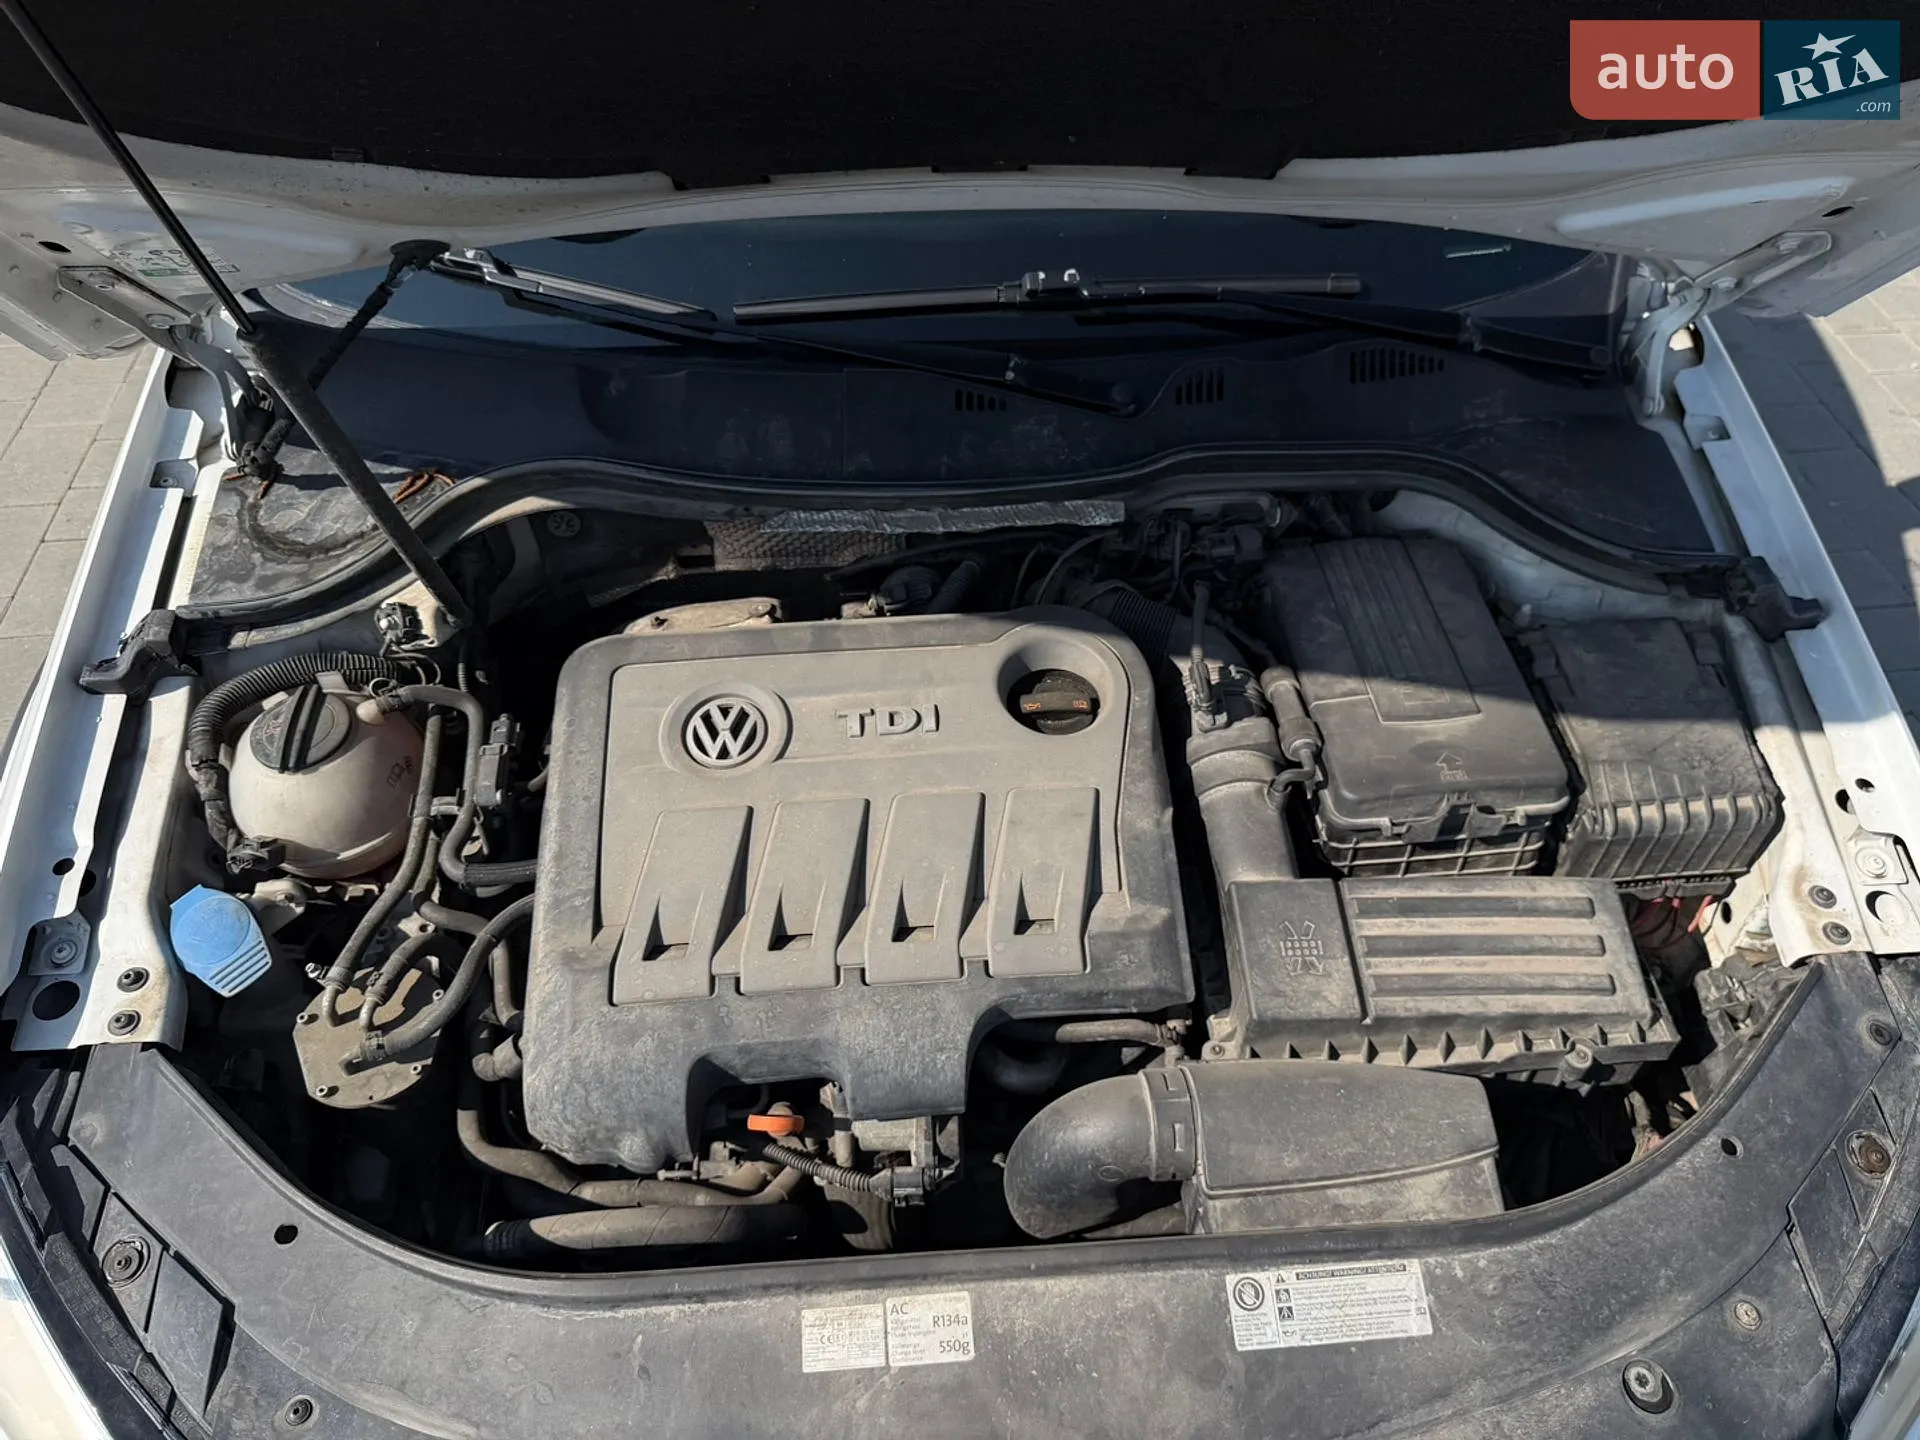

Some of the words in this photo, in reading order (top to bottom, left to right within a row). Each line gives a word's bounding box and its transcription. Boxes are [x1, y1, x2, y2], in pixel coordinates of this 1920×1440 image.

[836, 703, 940, 739] TDI
[890, 1302, 909, 1315] AC
[933, 1313, 968, 1328] R134a
[939, 1339, 970, 1355] 550g
